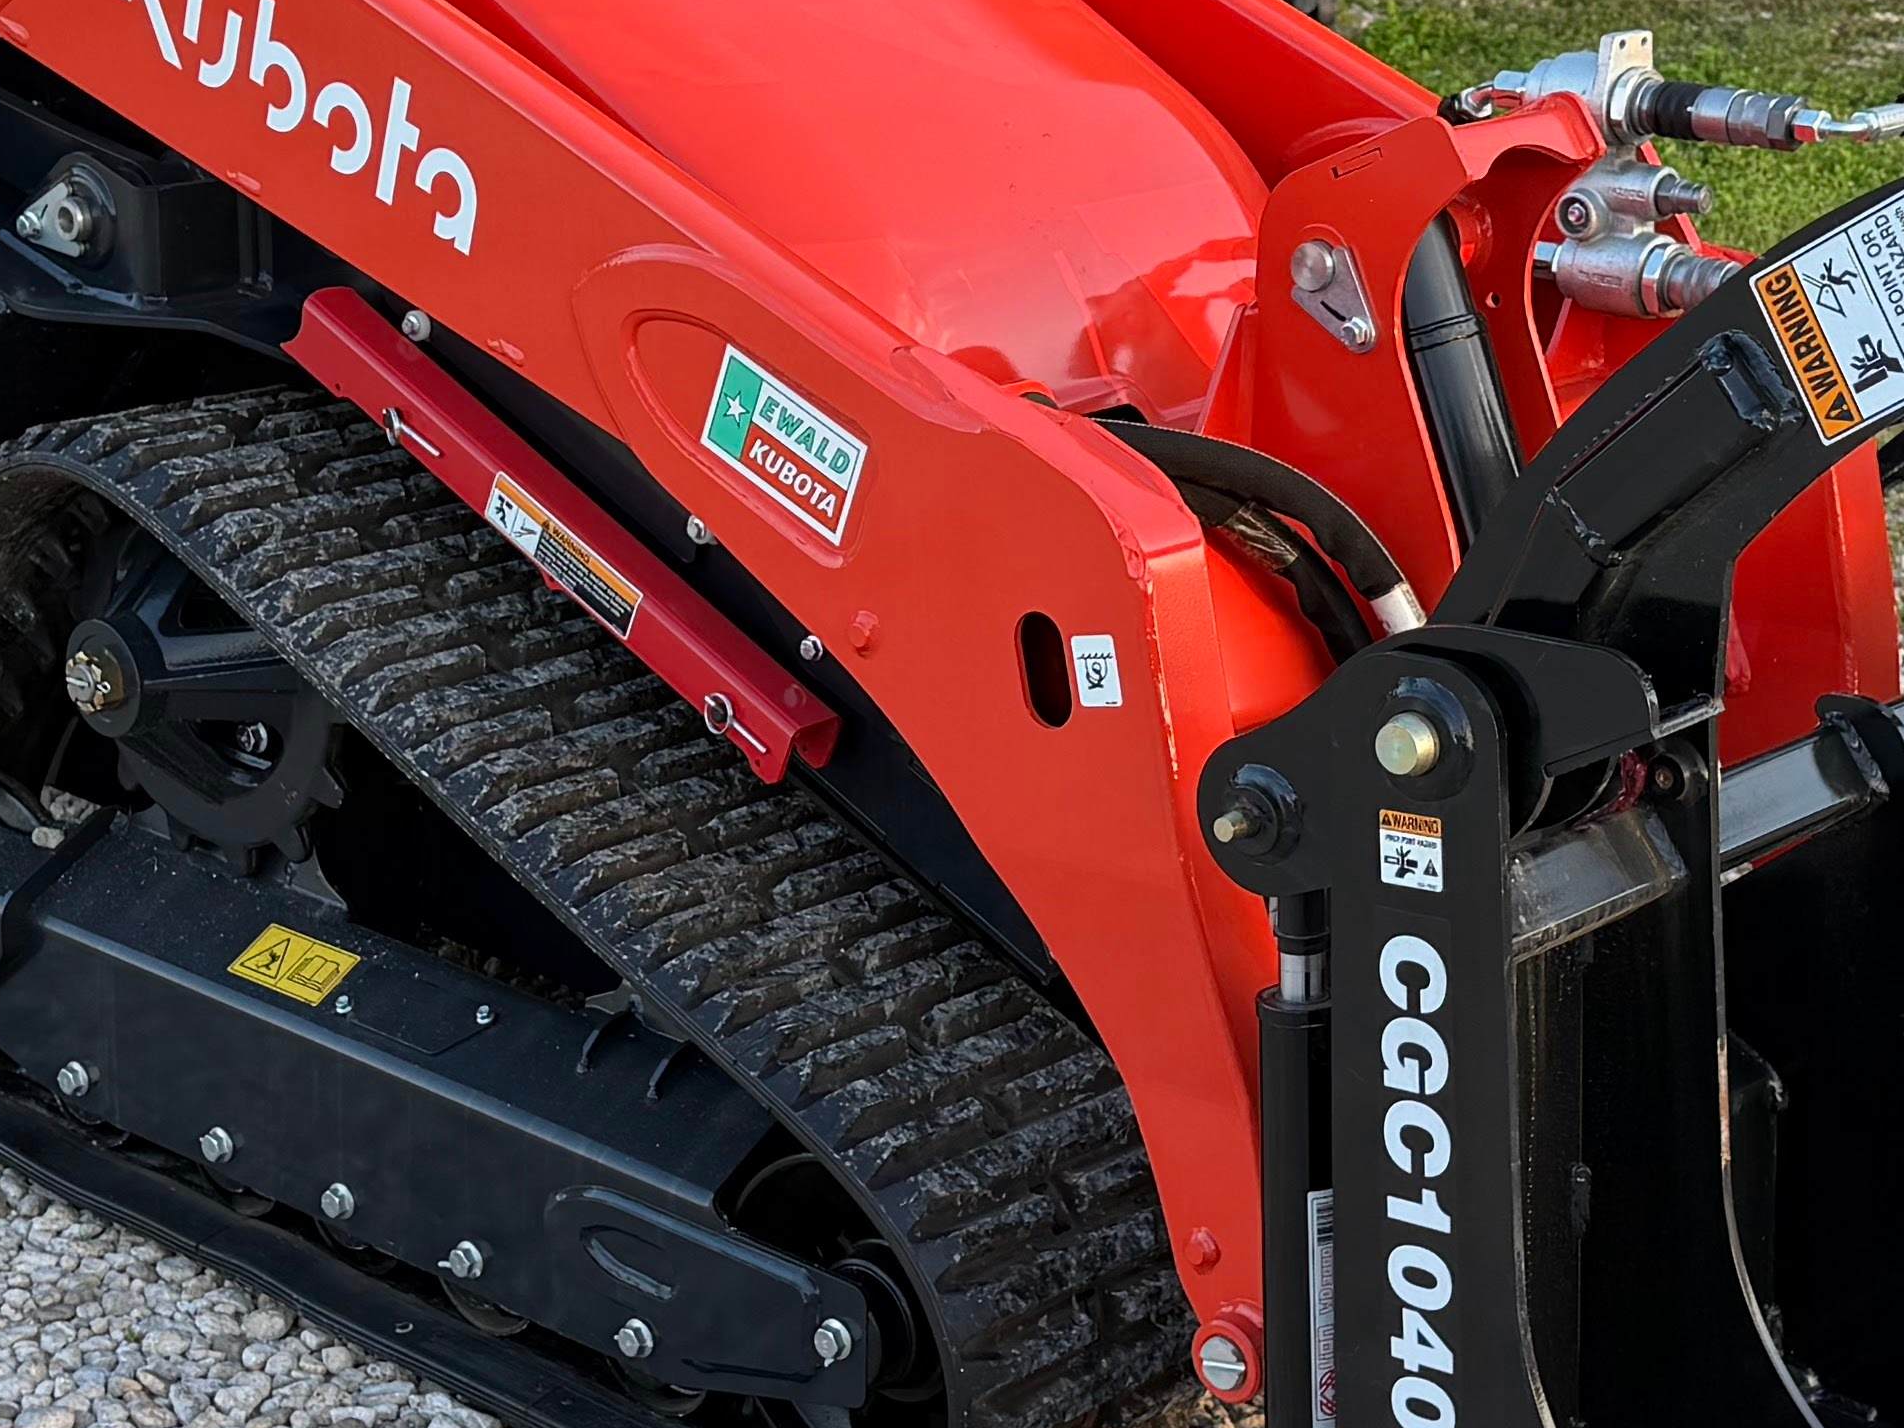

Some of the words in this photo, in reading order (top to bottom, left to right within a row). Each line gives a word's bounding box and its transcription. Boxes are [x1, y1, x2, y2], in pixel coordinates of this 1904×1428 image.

[1860, 228, 1882, 257] OR
[1765, 270, 1838, 399] WARNING
[759, 396, 851, 475] EWALD
[748, 439, 837, 518] KUBOTA
[1391, 812, 1439, 834] WARNING
